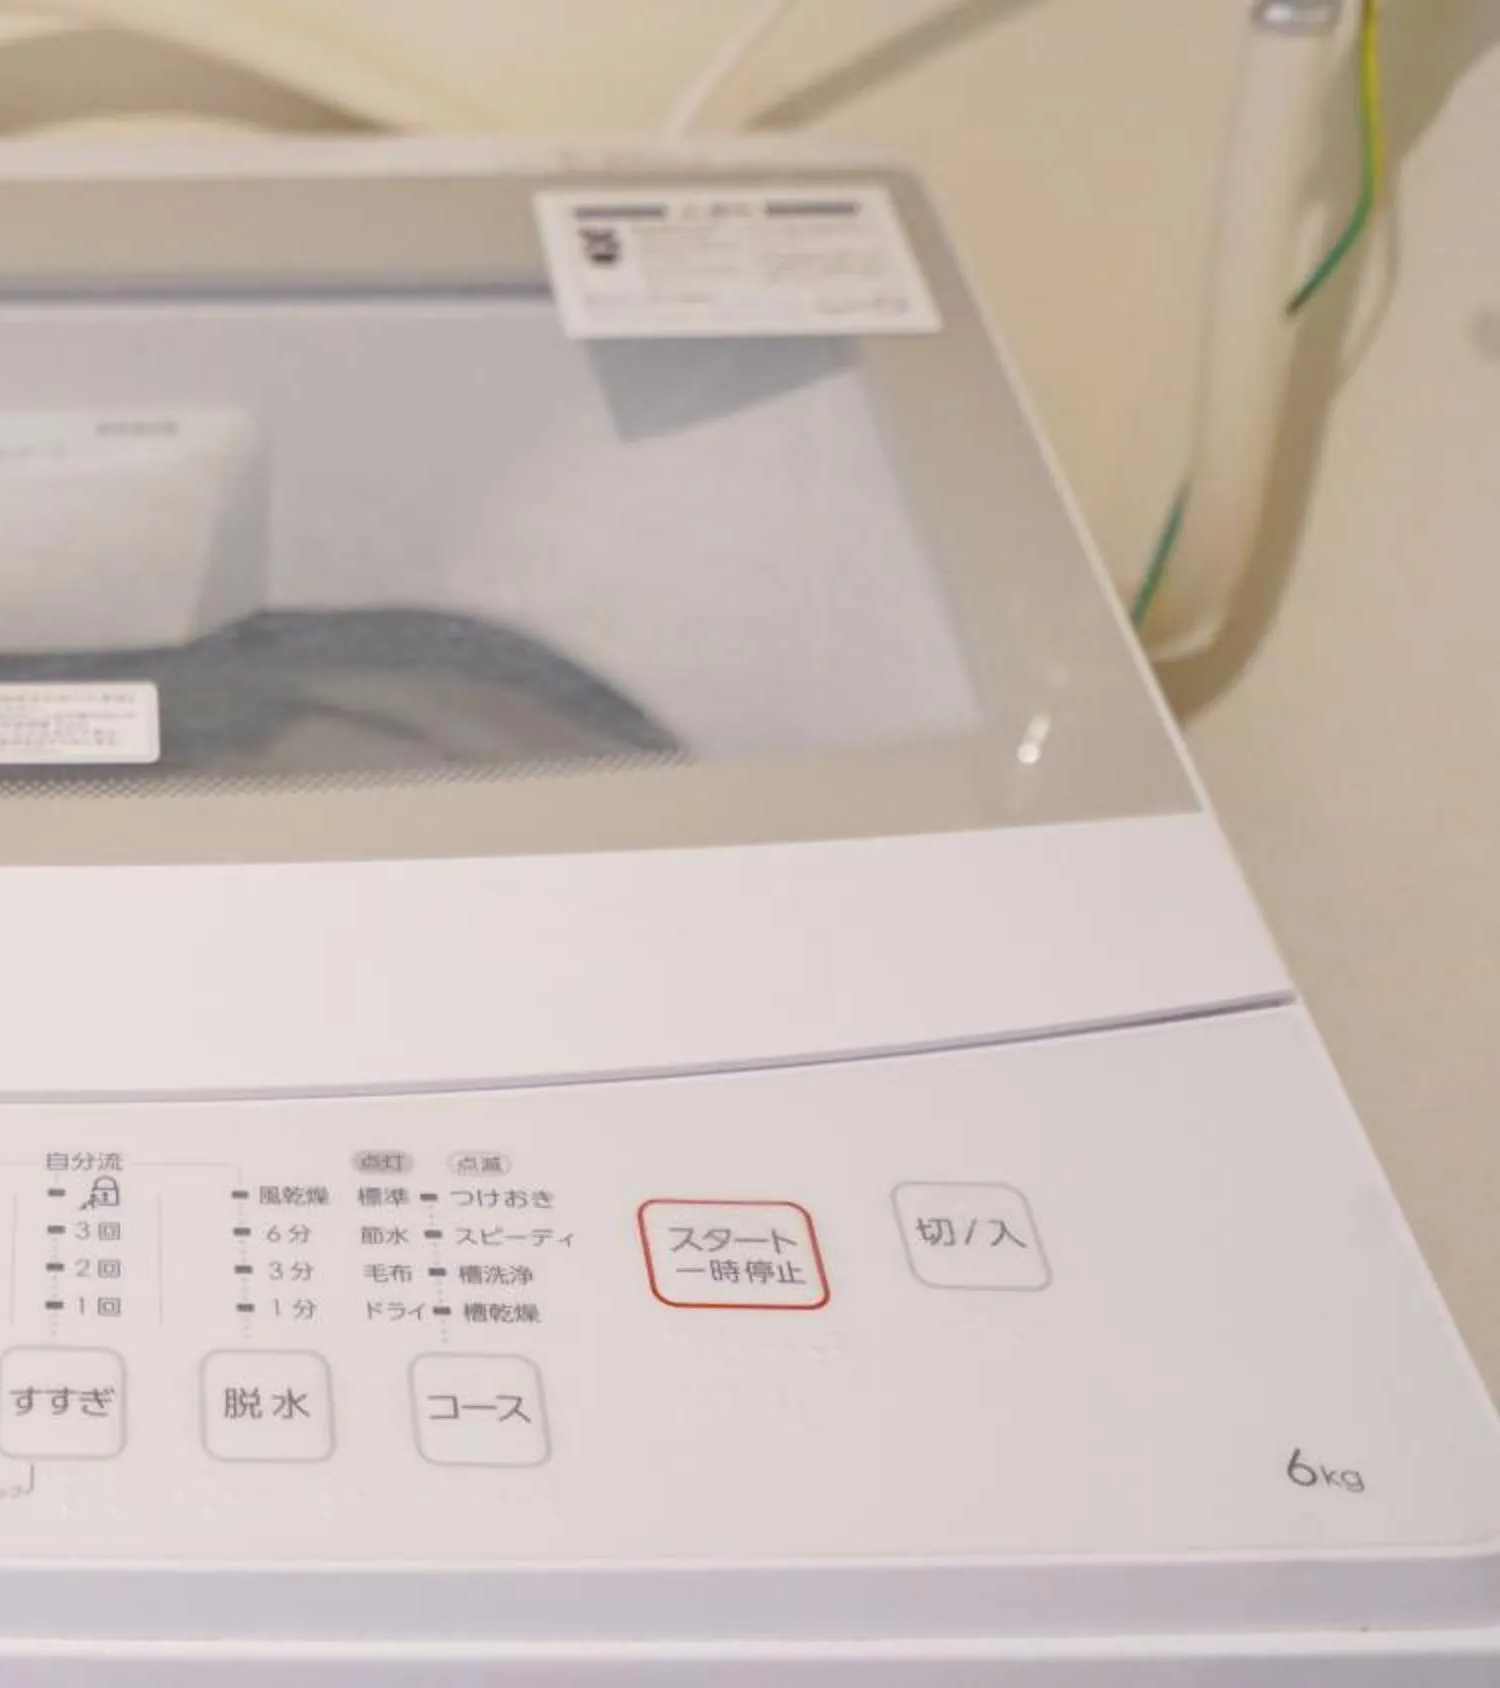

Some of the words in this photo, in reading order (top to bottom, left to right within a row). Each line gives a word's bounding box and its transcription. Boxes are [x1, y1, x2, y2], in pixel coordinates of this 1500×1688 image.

[46, 1152, 124, 1172] 自分流
[450, 1188, 553, 1209] つけおき
[456, 1226, 574, 1248] スピーディ
[668, 1227, 798, 1255] スタート
[916, 1217, 1027, 1248] 切/入
[365, 1264, 412, 1283] 毛布
[676, 1259, 807, 1285] 一時停止
[367, 1301, 425, 1321] ドライ
[9, 1386, 116, 1417] すすぎ
[224, 1387, 310, 1420] 脱水
[427, 1395, 532, 1423] コース
[1286, 1448, 1365, 1493] 6kg
